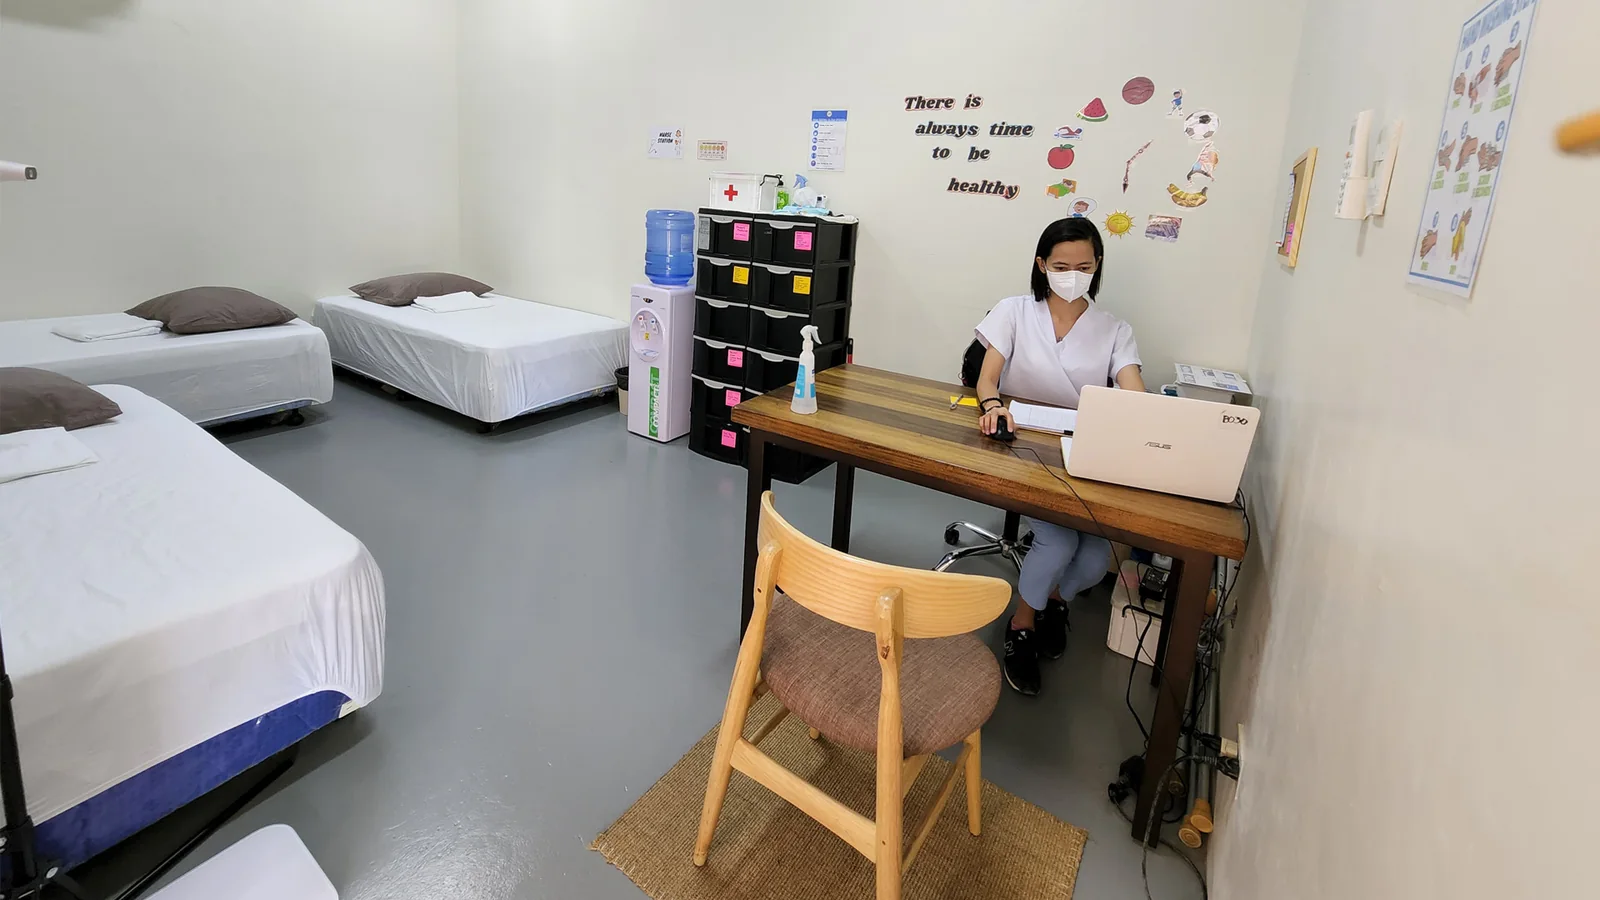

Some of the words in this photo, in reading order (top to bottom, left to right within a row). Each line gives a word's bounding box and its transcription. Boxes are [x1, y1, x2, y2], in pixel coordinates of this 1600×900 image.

[905, 95, 955, 110] There
[964, 94, 982, 109] is
[915, 121, 979, 138] always
[989, 121, 1033, 136] time
[932, 146, 950, 159] to
[968, 146, 990, 161] be
[947, 177, 1019, 200] healthy
[1144, 441, 1172, 450] ASUS
